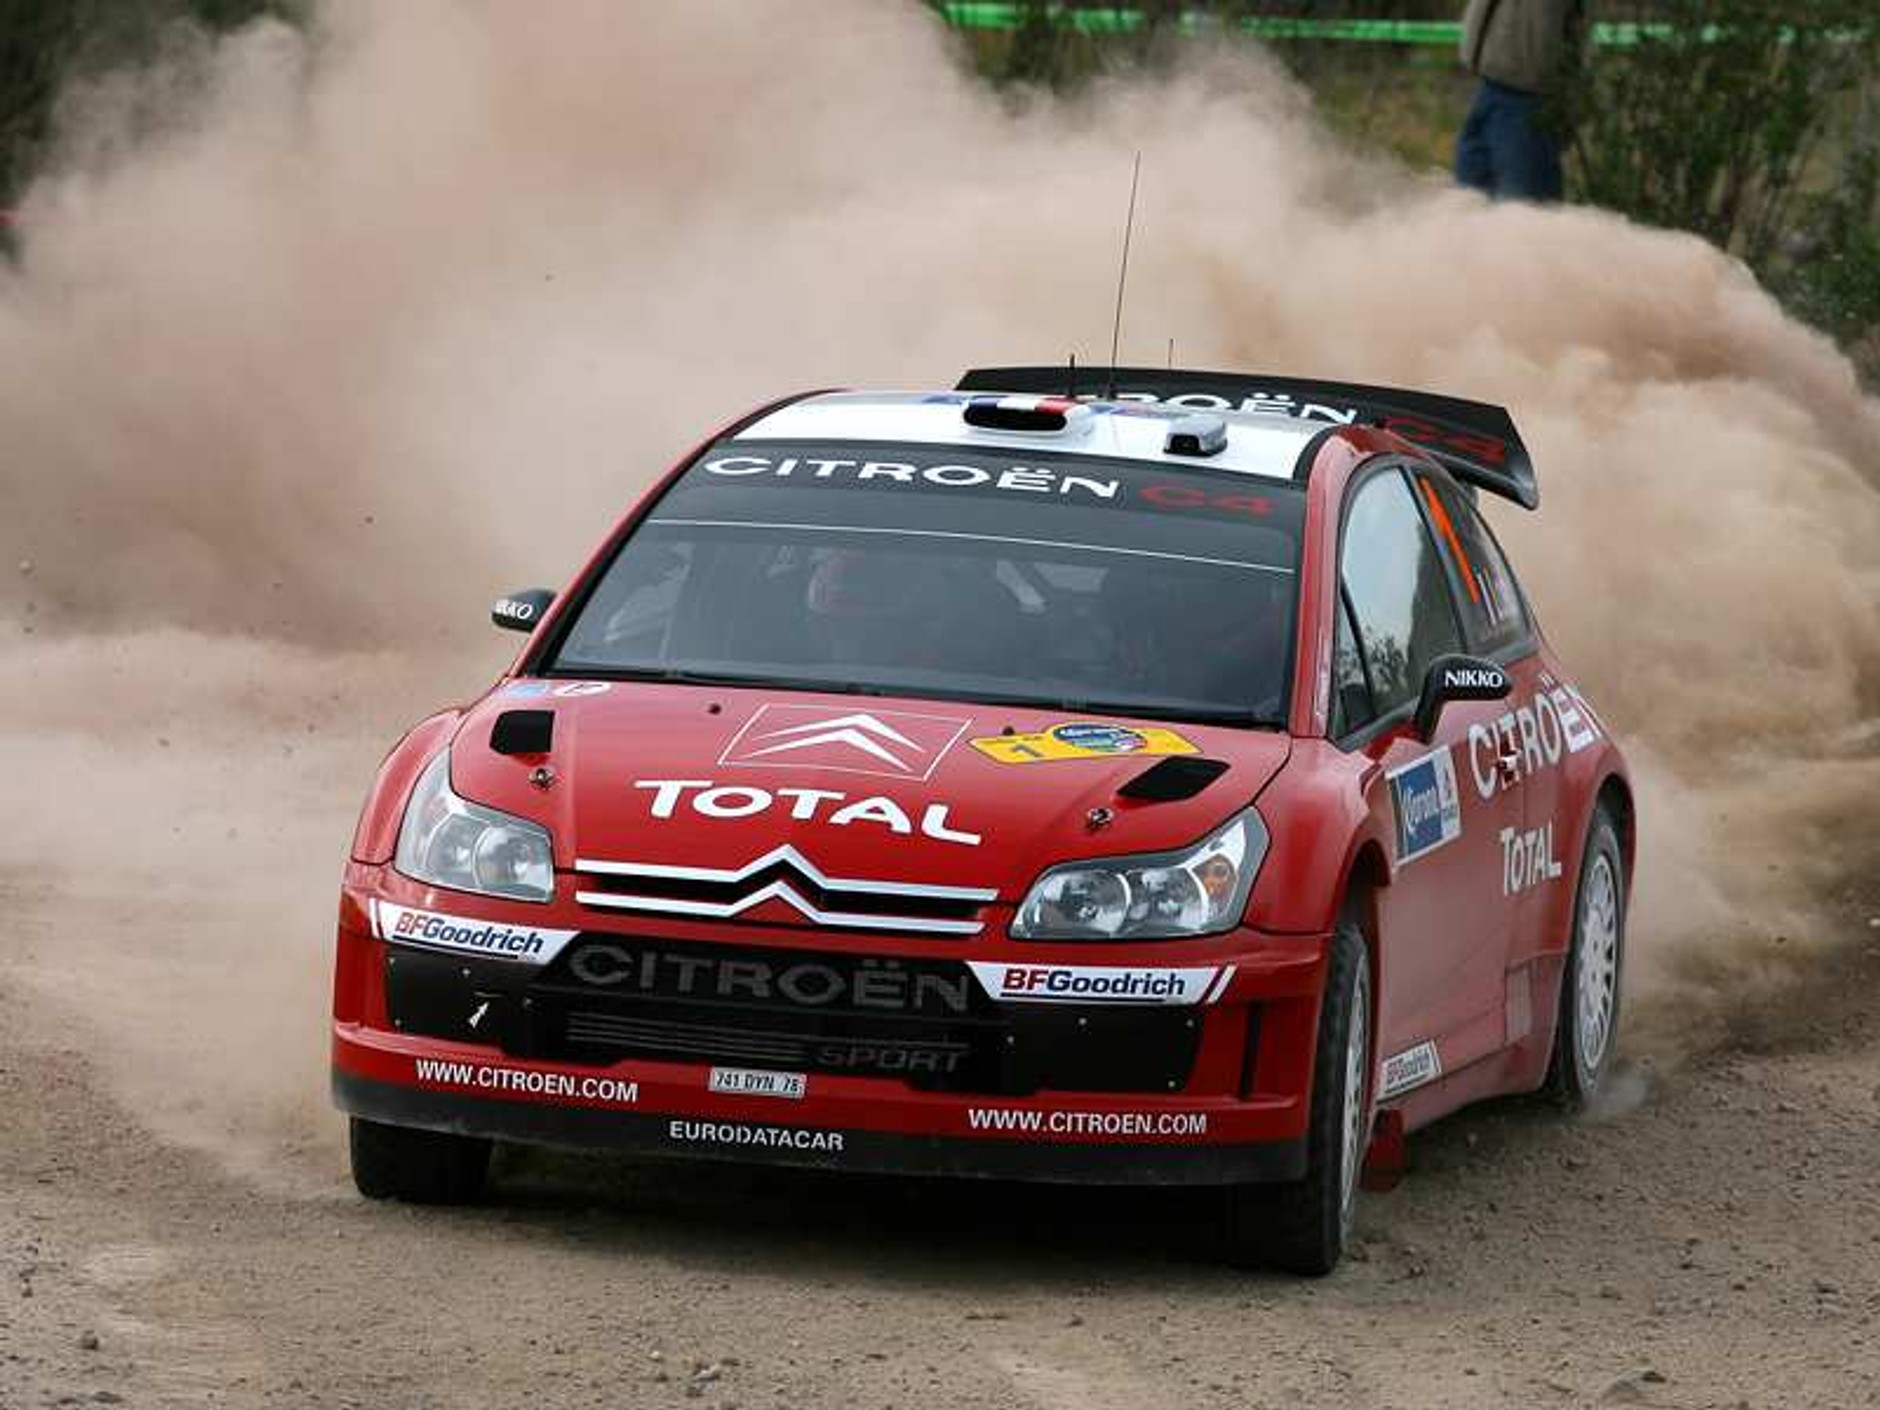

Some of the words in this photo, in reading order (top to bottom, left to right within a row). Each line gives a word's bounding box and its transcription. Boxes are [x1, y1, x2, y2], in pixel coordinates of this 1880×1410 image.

[704, 455, 1120, 498] CITROËN
[1139, 482, 1273, 516] C4
[1445, 670, 1504, 688] NIKKO
[634, 779, 982, 846] TOTAL
[1501, 820, 1561, 896] TOTAL
[395, 911, 545, 954] BFGoodrich
[569, 943, 969, 1011] CITROËN
[1002, 968, 1186, 995] BFGoodrich
[416, 1058, 639, 1103] WWW.CITROEN.COM
[817, 1045, 968, 1073] SPORT
[668, 1119, 844, 1151] EURODATACAR
[968, 1108, 1207, 1134] WWW.CITROEN.COM
